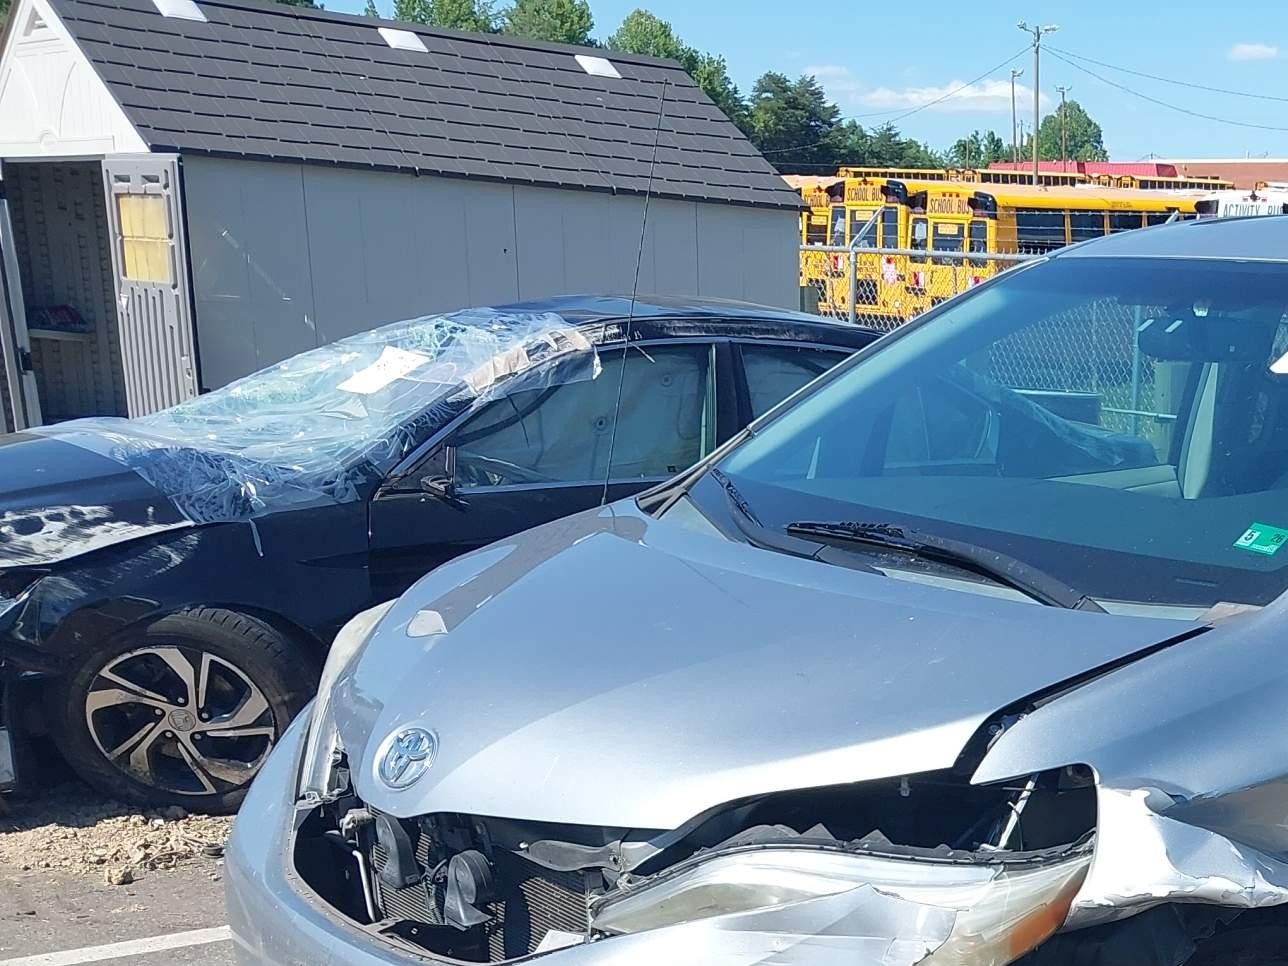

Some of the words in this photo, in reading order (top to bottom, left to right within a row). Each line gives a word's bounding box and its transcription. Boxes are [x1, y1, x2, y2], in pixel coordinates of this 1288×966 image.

[847, 187, 868, 201] SCHOOL
[872, 187, 883, 201] BUS
[930, 198, 953, 213] SCHOOL
[958, 199, 970, 214] BUS
[1223, 203, 1261, 217] ACTIVITY
[1244, 530, 1257, 541] 5
